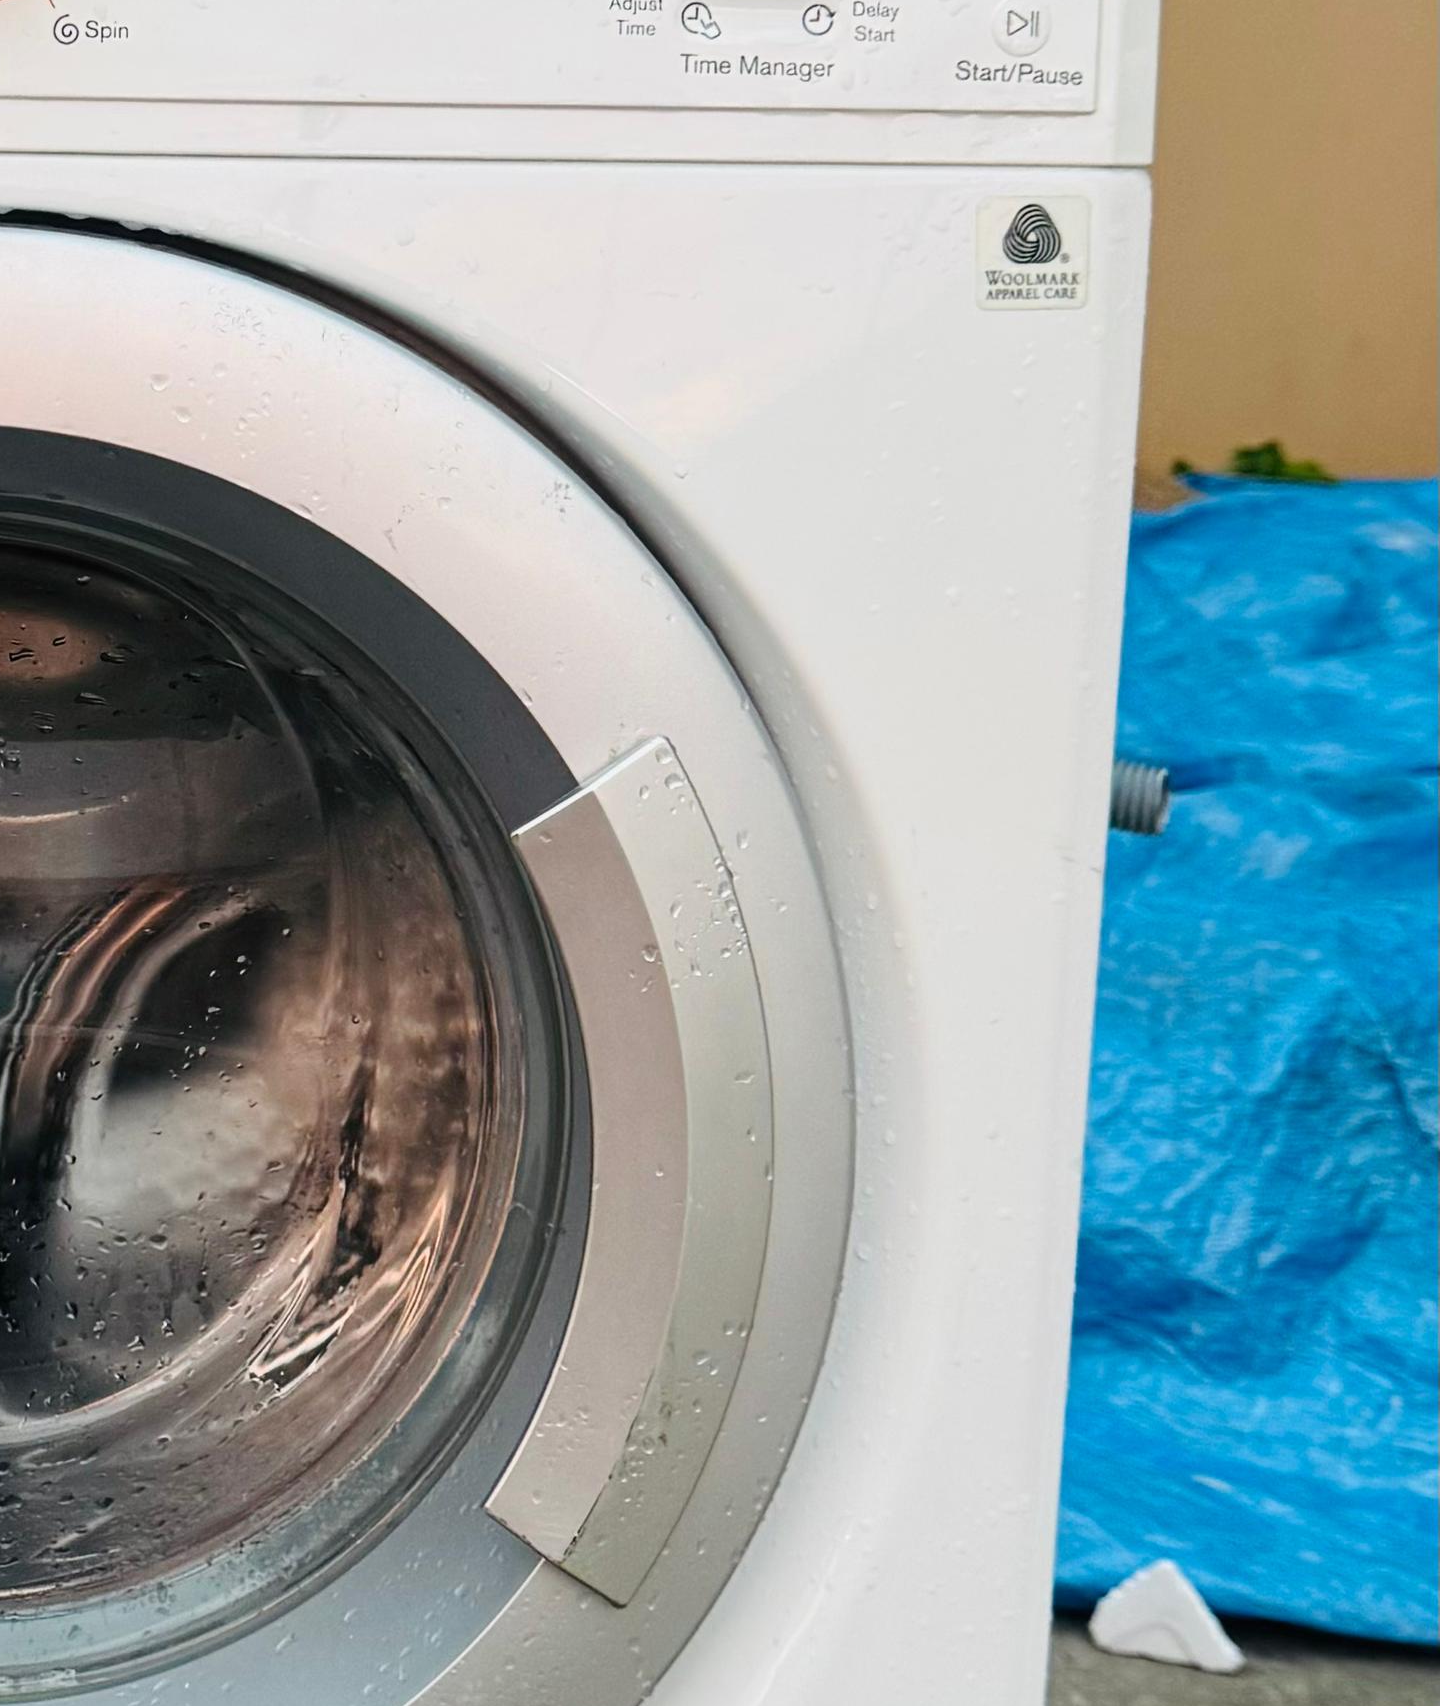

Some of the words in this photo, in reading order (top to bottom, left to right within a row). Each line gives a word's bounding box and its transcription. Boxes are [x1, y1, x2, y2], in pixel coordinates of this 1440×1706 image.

[852, 1, 899, 22] Delay
[85, 20, 129, 43] Spin
[616, 20, 656, 37] Time
[854, 26, 896, 43] Start
[680, 54, 731, 76] Time
[739, 55, 835, 82] Manager
[955, 61, 1084, 87] Start/Pause
[985, 270, 1081, 286] WOOLMARK
[1043, 287, 1078, 300] CARE
